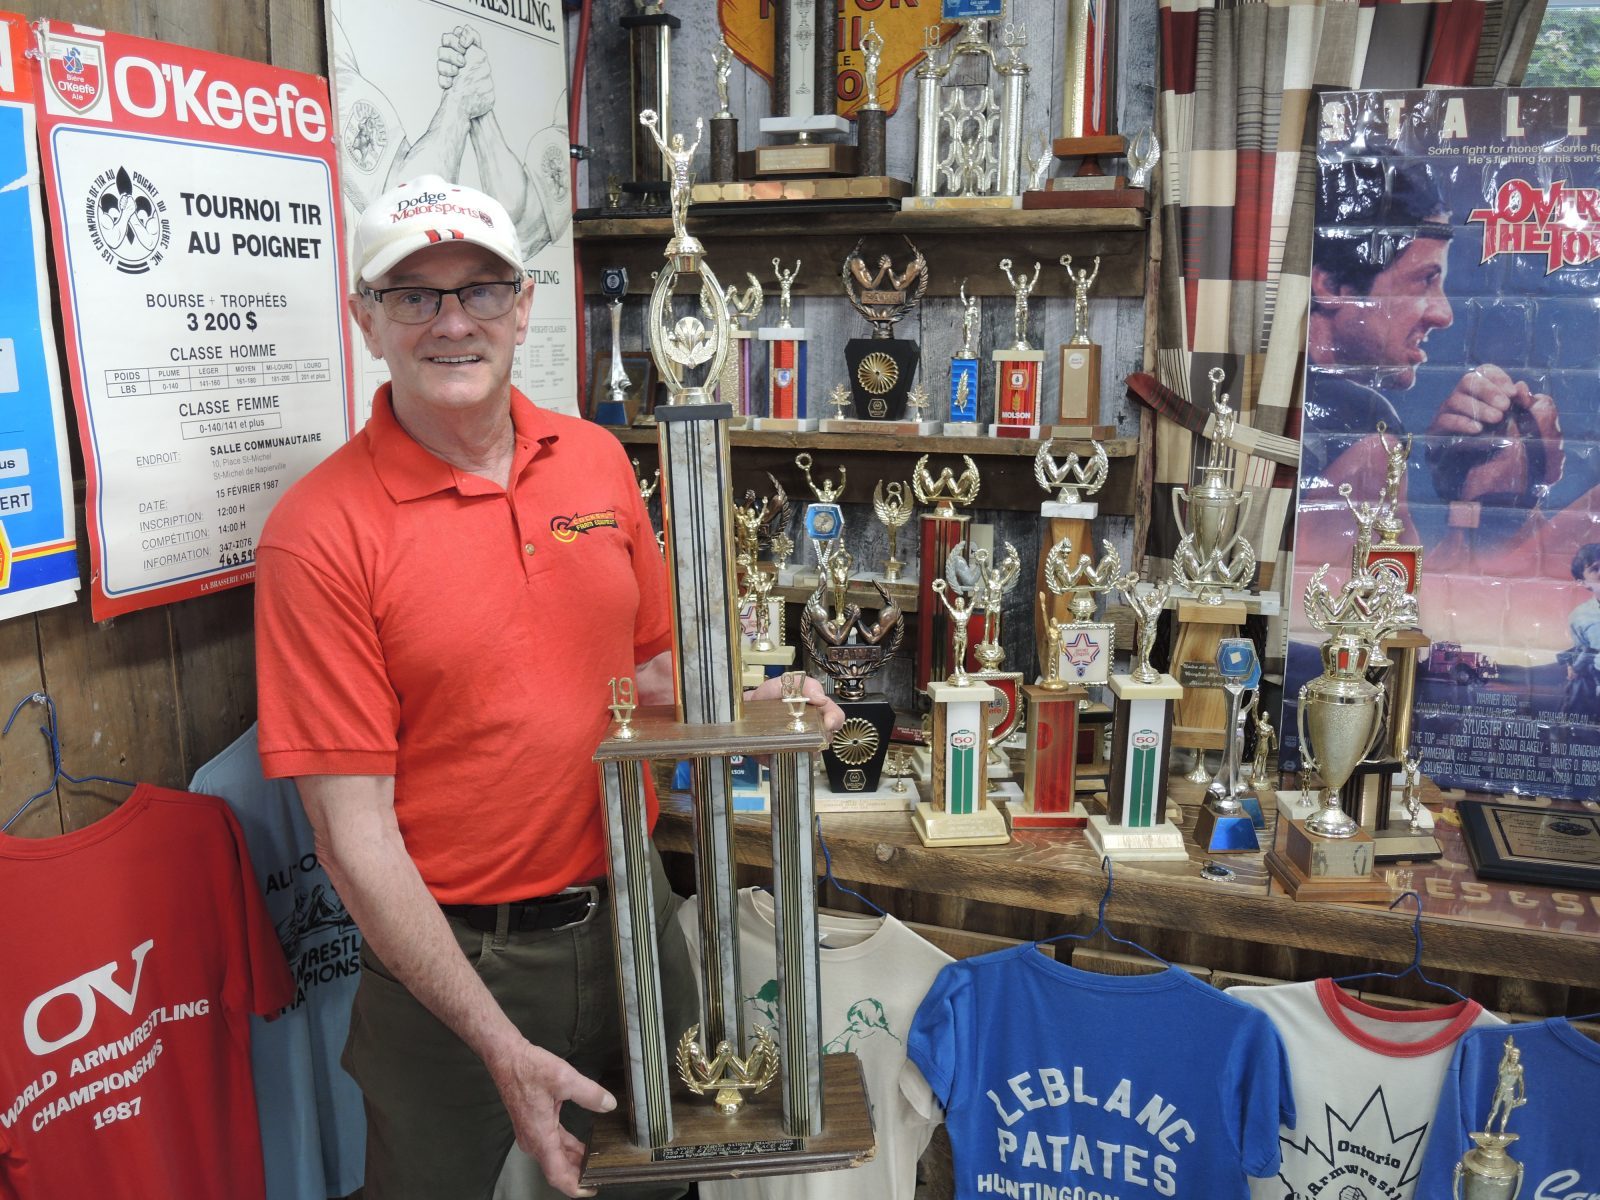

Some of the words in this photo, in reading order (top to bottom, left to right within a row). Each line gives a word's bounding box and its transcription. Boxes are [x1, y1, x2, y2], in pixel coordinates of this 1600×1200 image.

[58, 81, 95, 94] O'Keefe
[72, 93, 83, 101] Ale
[114, 56, 327, 143] O'Keefe
[1428, 146, 1460, 156] Some
[1462, 145, 1487, 157] fight
[1489, 145, 1505, 154] for
[1555, 145, 1588, 153] Some
[1468, 155, 1492, 165] He's
[1494, 154, 1535, 166] fighting
[1538, 154, 1553, 163] for
[1555, 154, 1571, 163] his
[94, 174, 106, 189] TIR
[105, 169, 116, 181] AU
[133, 171, 159, 198] POIGNET
[89, 186, 99, 198] DE
[156, 200, 167, 213] DU
[180, 192, 281, 222] TOURNOI
[289, 202, 322, 226] TIR
[398, 192, 447, 213] Dodge
[390, 203, 480, 224] Motorsports
[86, 197, 104, 251] CHAMPIONS
[188, 231, 220, 255] AU
[233, 234, 322, 259] POIGNET
[1465, 208, 1553, 265] THE
[146, 294, 205, 308] BOURSE
[220, 293, 288, 308] TROPHÉES
[187, 313, 199, 331] 3
[204, 312, 241, 331] 200
[246, 310, 258, 333] $
[170, 346, 223, 361] CLASSE
[230, 344, 277, 358] HOMME
[114, 371, 141, 381] POIDS
[158, 369, 181, 378] PLUME
[235, 364, 256, 373] MOYEN
[266, 363, 293, 371] MI-LOURD
[304, 361, 322, 369] LOURD
[121, 385, 137, 394] LBS
[162, 382, 179, 391] 0-140
[179, 400, 230, 417] CLASSE
[236, 395, 280, 412] FEMME
[1002, 411, 1031, 419] MOLSON
[199, 420, 237, 434] 0-140/141
[239, 420, 248, 430] et
[249, 418, 265, 431] plus
[210, 442, 241, 456] SALLE
[244, 433, 322, 451] COMMUNAUTAIRE
[136, 451, 180, 466] ENDROIT:
[222, 457, 241, 466] Place
[242, 452, 272, 464] St-Michel
[213, 468, 245, 480] St-Michel
[245, 467, 254, 475] de
[254, 462, 287, 475] Napierville
[216, 488, 226, 499] 15
[227, 482, 261, 497] FÉVRIER
[263, 479, 279, 491] 1987
[139, 500, 168, 513] DATE:
[217, 505, 238, 517] 12:00
[239, 503, 246, 513] H
[139, 512, 204, 532] INSCRIPTION:
[218, 522, 239, 534] 14:00
[240, 520, 246, 530] H
[200, 582, 209, 591] LA
[210, 576, 239, 589] BRASSERIE
[1477, 692, 1500, 705] WARNER
[1463, 718, 1502, 735] SYLVESTER
[1505, 721, 1541, 739] STALLONE
[1136, 736, 1155, 744] 50
[1424, 732, 1436, 745] TOP
[1450, 734, 1472, 747] ROBERT
[1472, 736, 1492, 749] LOGGIA
[1498, 738, 1518, 751] SUSAN
[1520, 740, 1545, 754] BLAKELY
[1550, 742, 1568, 755] DAVID
[1554, 757, 1572, 770] JAMES
[1423, 761, 1453, 774] SYLVESTER
[1454, 763, 1481, 777] STALLONE
[1495, 767, 1525, 780] MENAHEM
[1526, 769, 1546, 782] GOLAN
[1553, 771, 1573, 784] YORAM
[1574, 773, 1597, 786] GLOBUS
[0, 1070, 58, 1129] WORLD
[69, 999, 209, 1077] ARMWRESTLING
[32, 1038, 163, 1132] CHAMPIONSHIPS
[94, 1096, 142, 1130] 1987
[986, 1066, 1196, 1153] LEBLANC
[997, 1127, 1177, 1197] PATATES
[1337, 1140, 1401, 1169] Ontario
